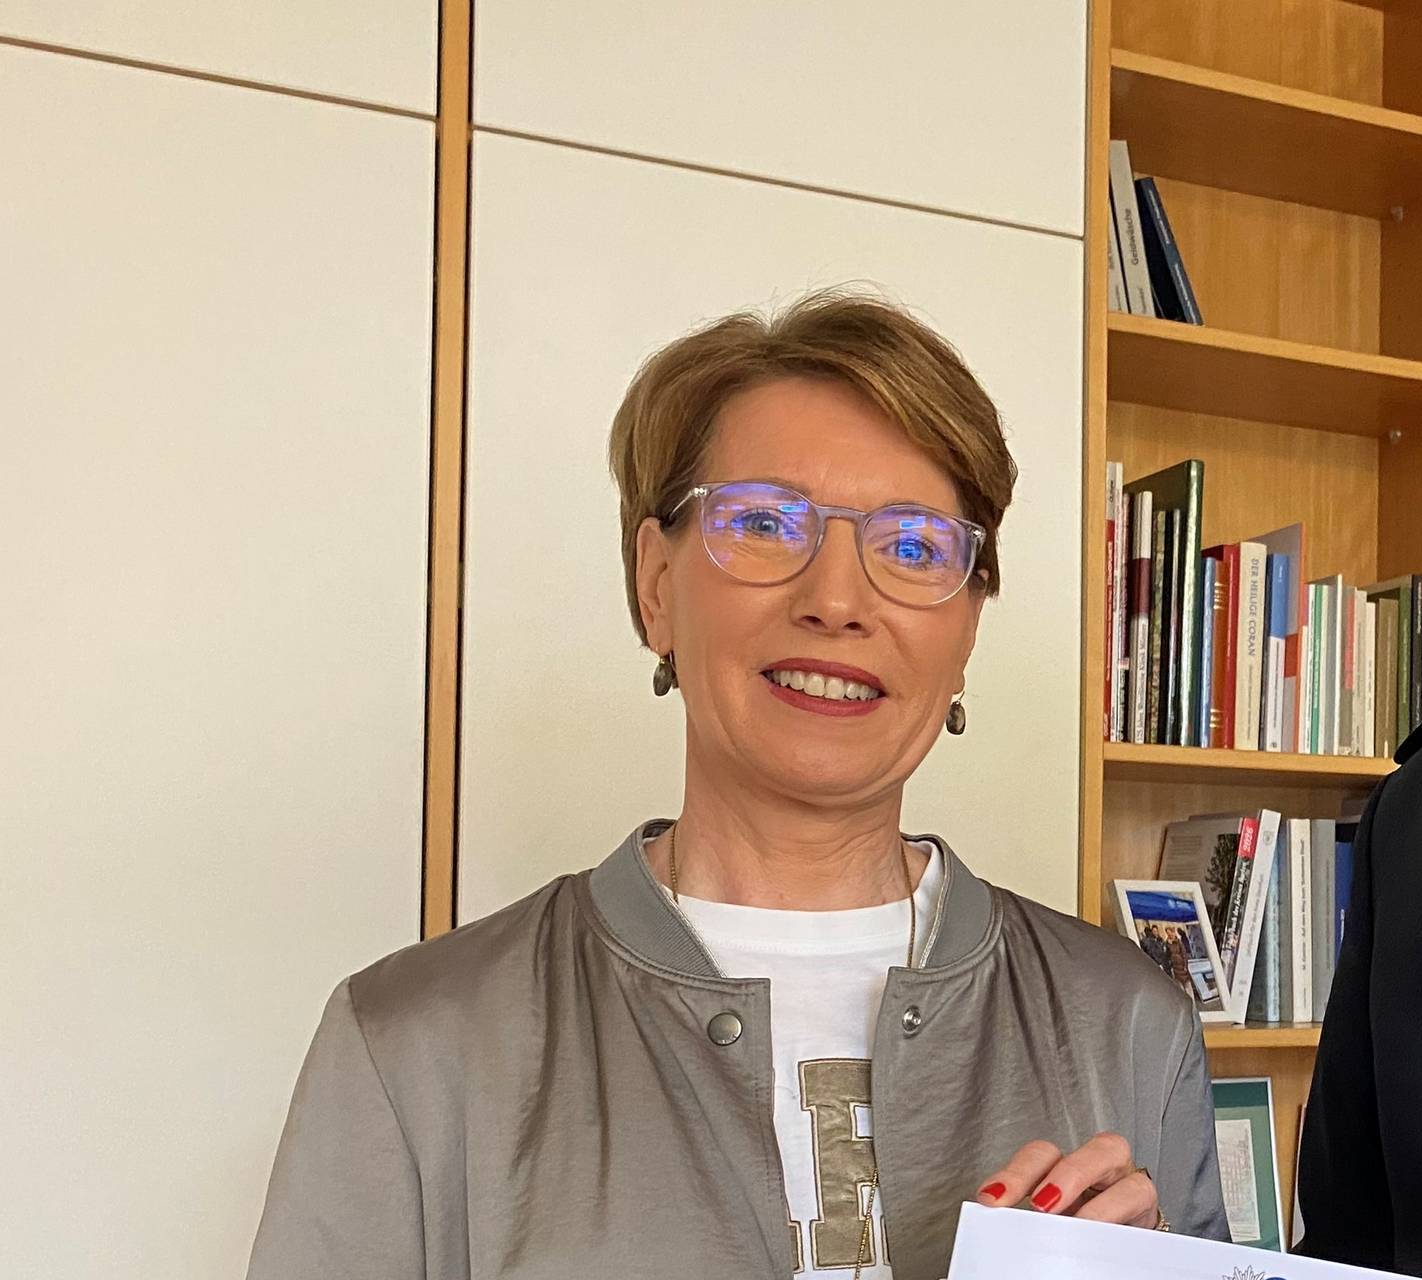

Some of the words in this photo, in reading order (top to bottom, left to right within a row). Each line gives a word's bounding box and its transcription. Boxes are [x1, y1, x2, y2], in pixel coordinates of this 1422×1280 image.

[1250, 558, 1259, 577] DER
[1249, 580, 1258, 617] HEILIGE
[1247, 620, 1257, 657] CORAN
